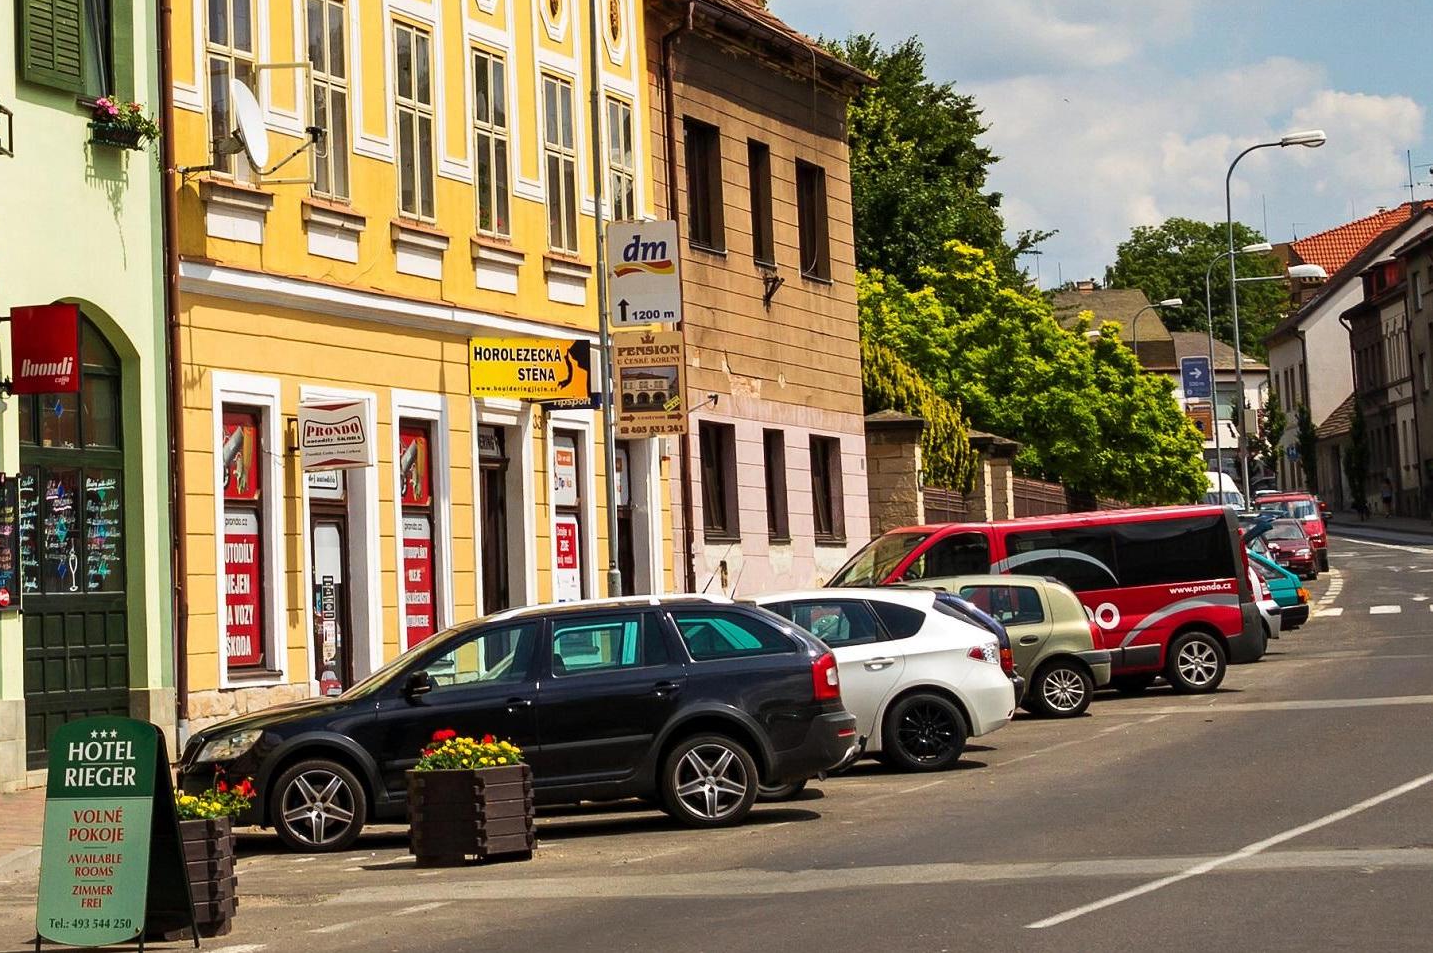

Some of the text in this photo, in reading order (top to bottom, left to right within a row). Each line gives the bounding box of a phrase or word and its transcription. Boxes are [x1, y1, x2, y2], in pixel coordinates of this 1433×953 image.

[623, 235, 667, 262] dm
[632, 310, 674, 320] 1200 m
[474, 345, 561, 362] HOROLEZECKÁ
[617, 345, 679, 356] PENSION
[21, 356, 73, 377] Buondi
[518, 364, 555, 381] STĚNA
[306, 422, 359, 437] PRONDO
[224, 539, 254, 563] UTODÍLY
[1169, 582, 1231, 594] www.prondo.cz
[225, 605, 254, 626] A VOZY
[227, 632, 252, 657] ŠKODA
[68, 741, 136, 761] HOTEL
[64, 767, 136, 787] RIEGER
[74, 806, 123, 823] VOLNÉ
[68, 827, 124, 843] POKOJE
[68, 853, 122, 864] AVAILABLE
[74, 866, 114, 877] ROOMS
[72, 885, 113, 895] ZIMMER
[81, 897, 102, 908] FREI
[48, 918, 132, 929] Tel.: 493 544 250
